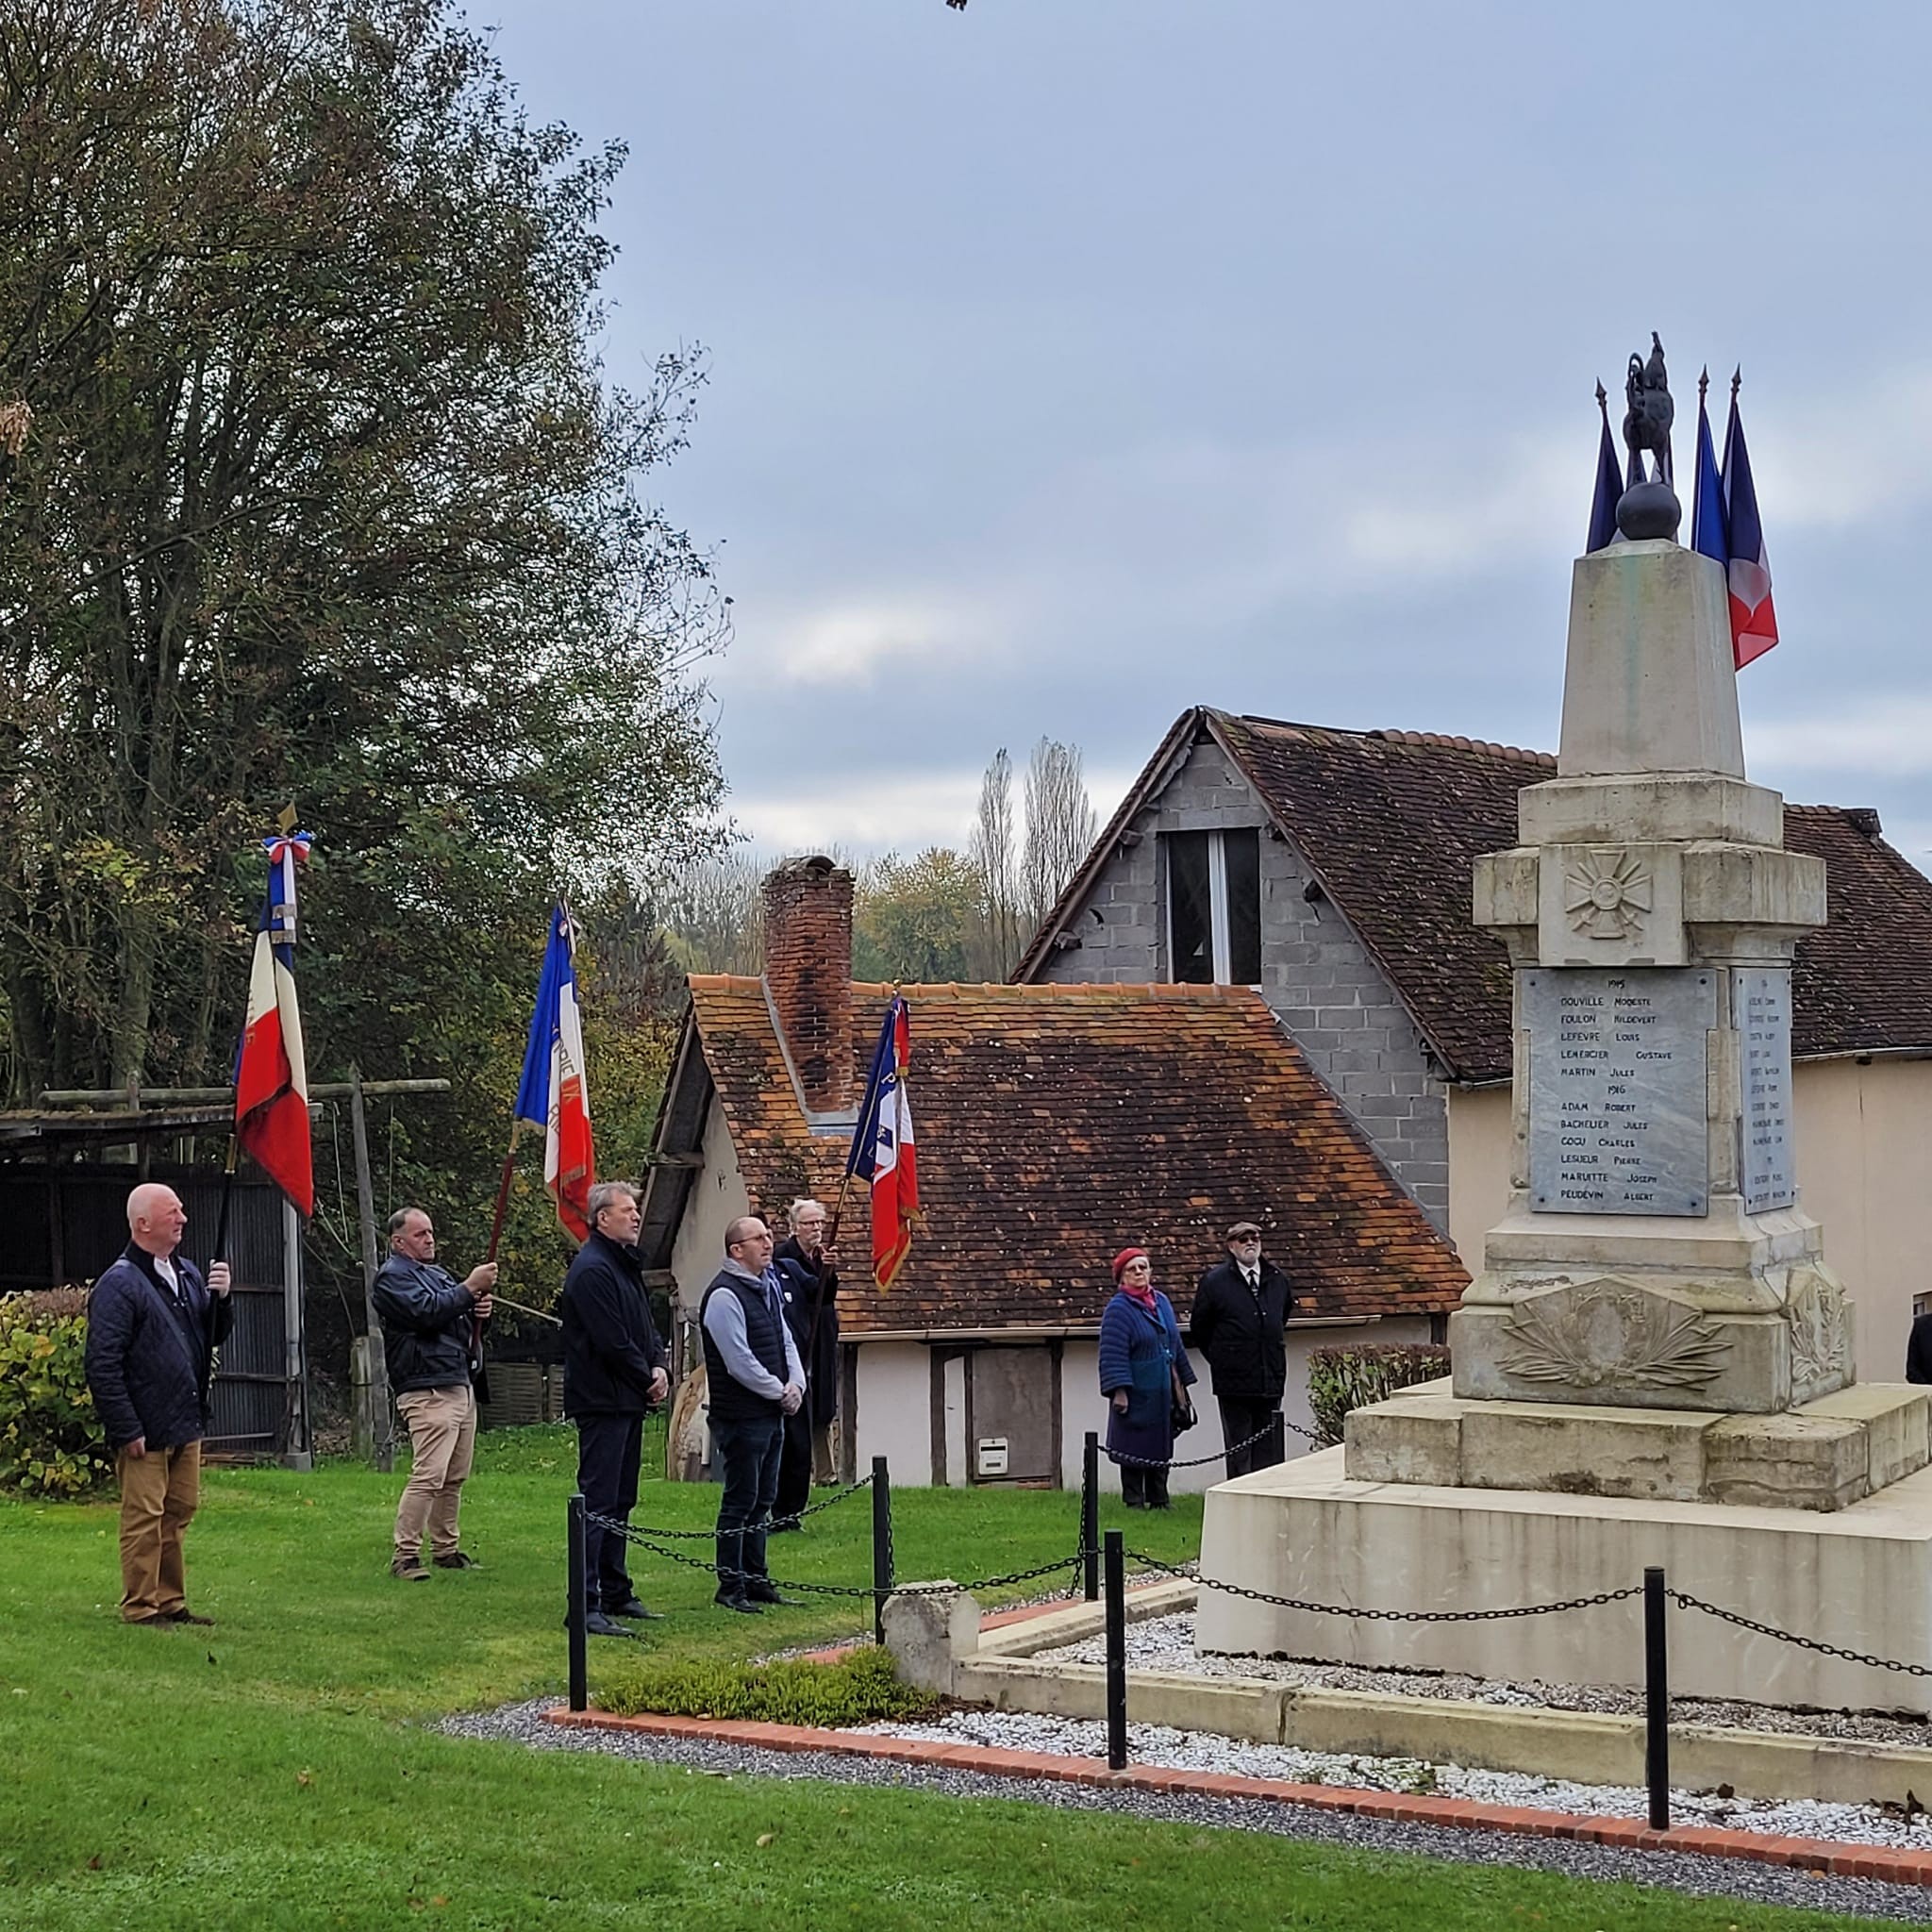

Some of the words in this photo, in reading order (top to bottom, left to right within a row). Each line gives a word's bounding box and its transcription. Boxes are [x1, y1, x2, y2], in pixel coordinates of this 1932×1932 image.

[1560, 1013, 1596, 1024] FOULON
[1615, 1032, 1640, 1042] LOUIS
[1560, 1049, 1608, 1059] LEMERCIER
[1635, 1050, 1672, 1060] GUSTAVE
[1560, 1067, 1595, 1076] MARTIN
[1609, 1068, 1634, 1077] JULES
[1607, 1084, 1625, 1095] 1916
[1560, 1102, 1588, 1111] ADAM
[1604, 1102, 1636, 1112] ROBERT
[1560, 1119, 1608, 1130] BACHELIER
[1623, 1121, 1648, 1130] JULES
[1598, 1138, 1635, 1148] CHARLES
[1613, 1156, 1641, 1166] PIERRE
[1623, 1191, 1653, 1201] ALBERT
